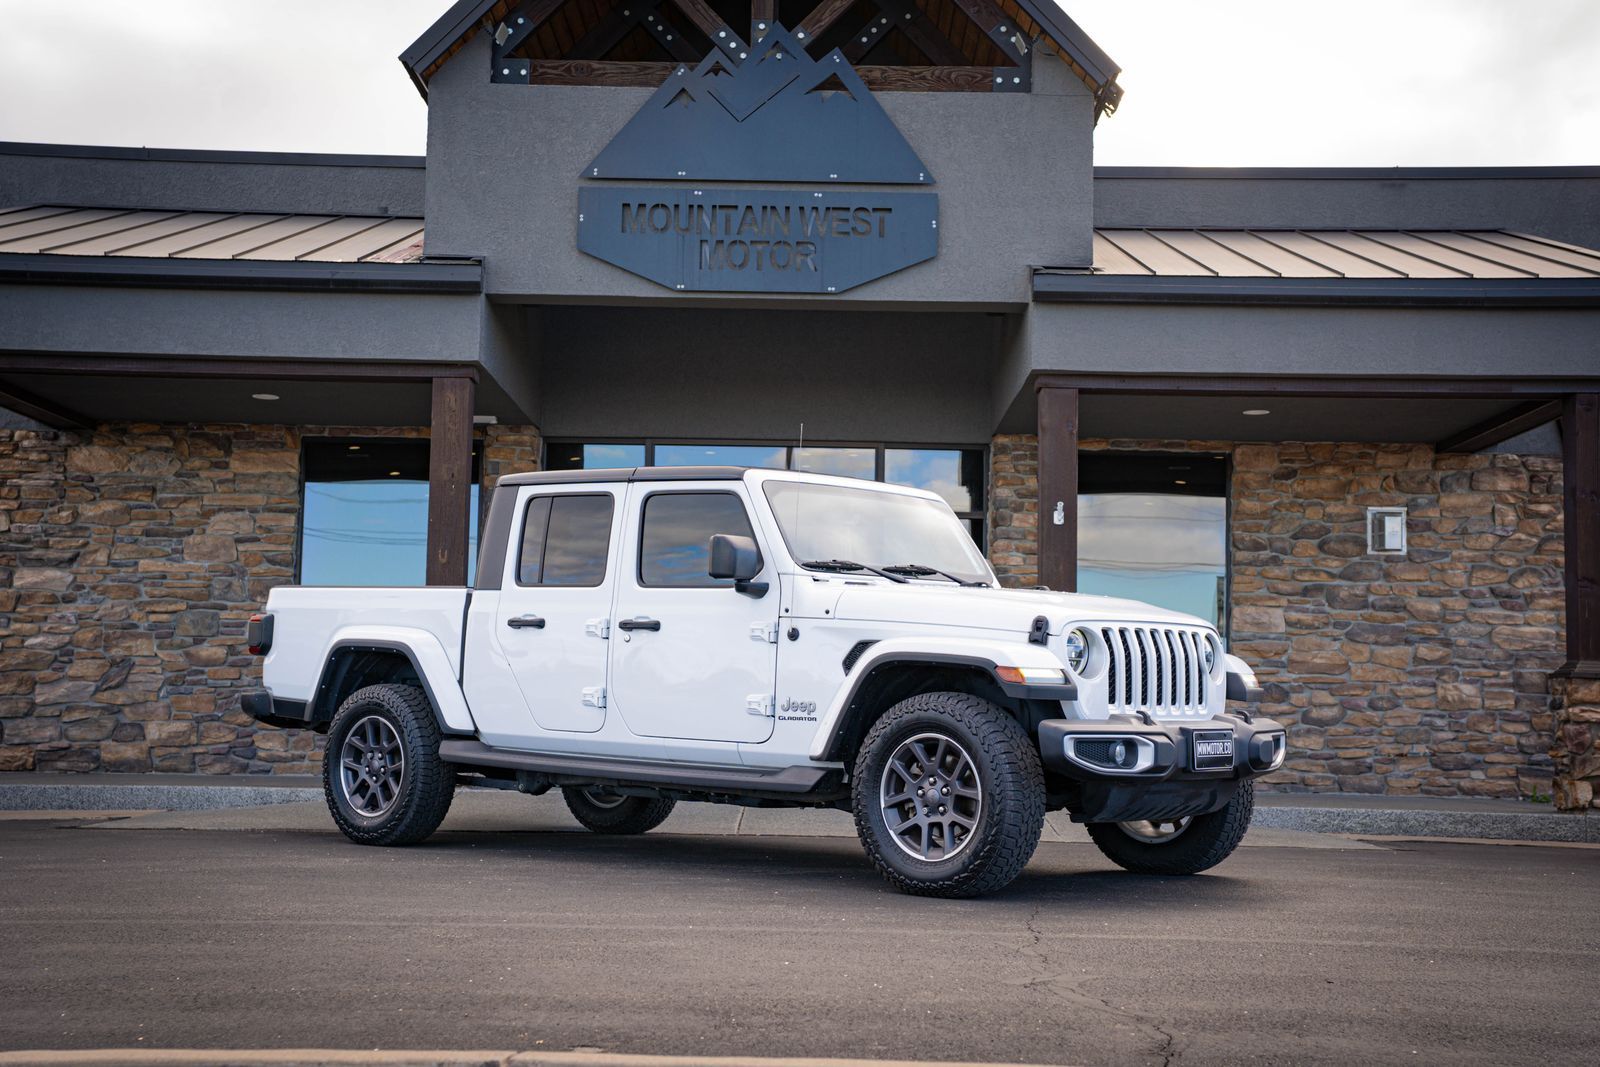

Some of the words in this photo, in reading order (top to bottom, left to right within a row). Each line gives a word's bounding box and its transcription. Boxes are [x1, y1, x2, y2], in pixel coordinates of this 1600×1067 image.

[621, 203, 790, 236] MOUNTAIN
[798, 205, 892, 239] WEST
[699, 239, 818, 273] MOTOR
[780, 696, 817, 715] Jeep
